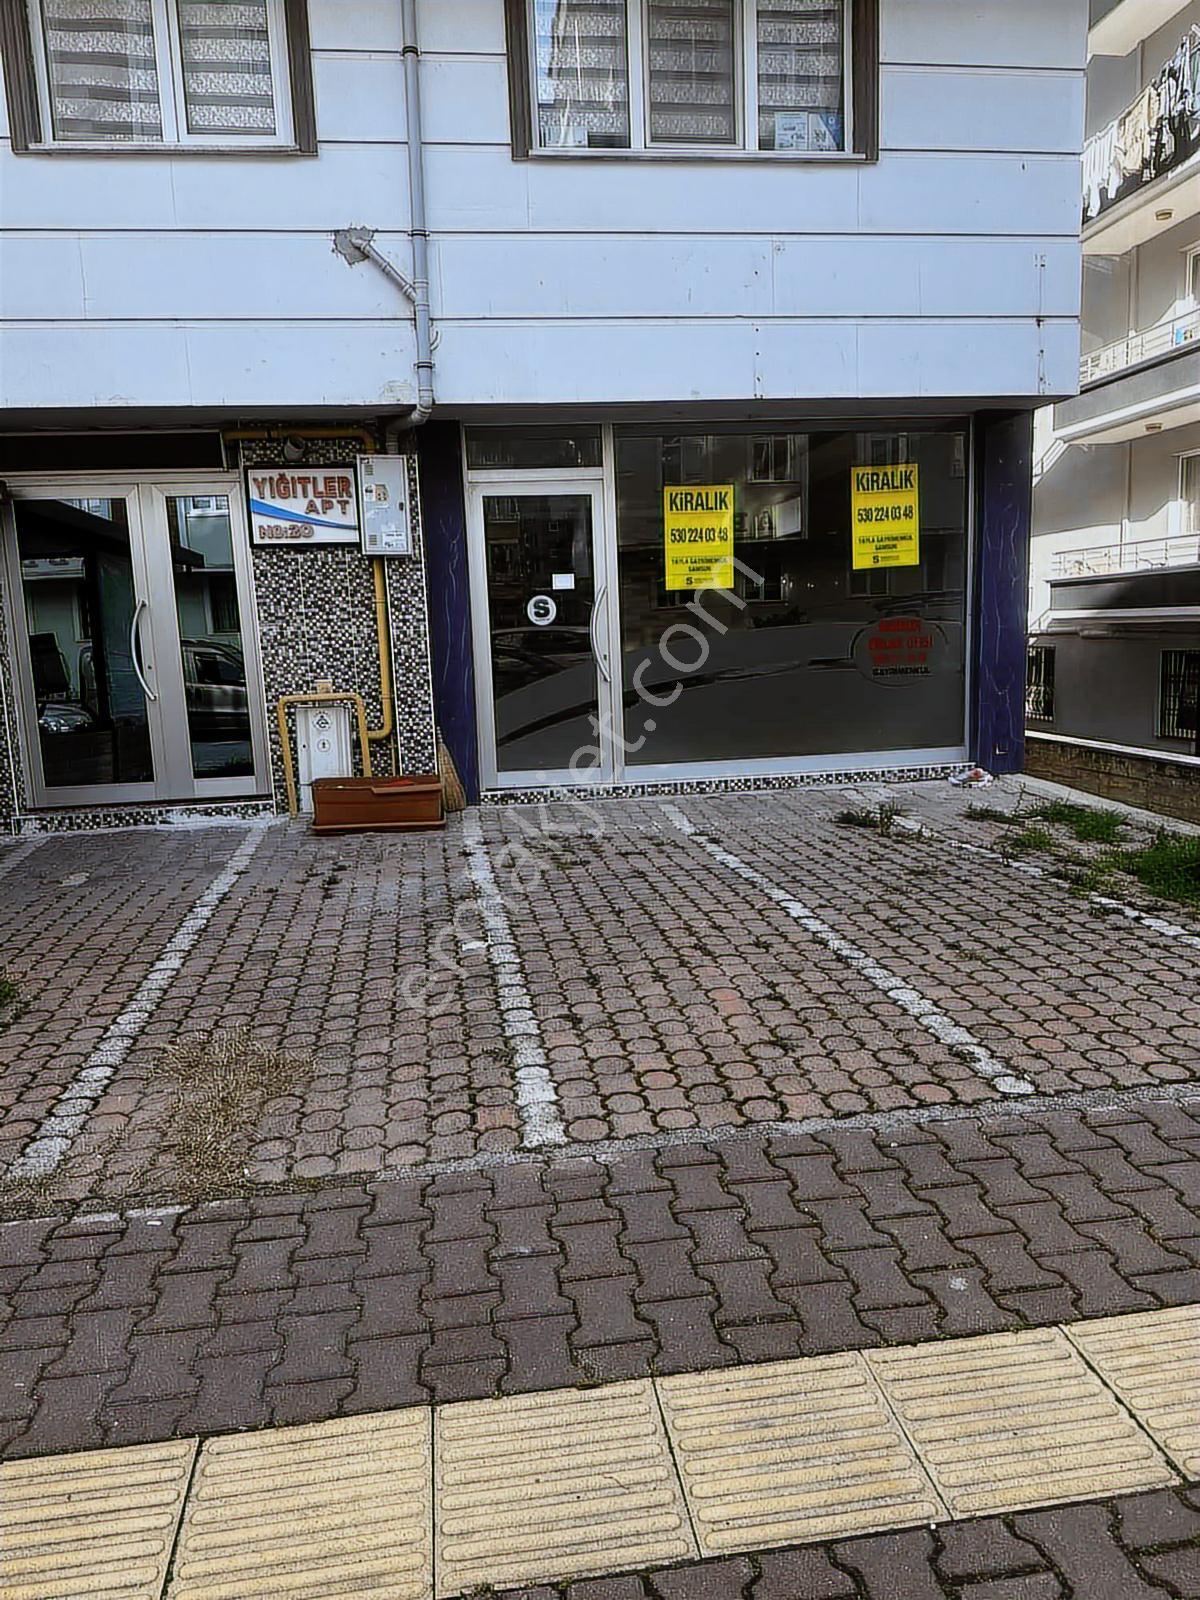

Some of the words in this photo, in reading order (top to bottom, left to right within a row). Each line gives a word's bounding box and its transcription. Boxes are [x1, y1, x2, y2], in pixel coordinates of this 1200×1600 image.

[305, 499, 350, 515] APT
[857, 507, 873, 523] 530
[874, 506, 889, 522] 224
[891, 505, 901, 521] 03
[903, 505, 914, 520] 48
[670, 528, 687, 543] 530
[687, 528, 704, 543] 224
[705, 527, 716, 542] 03
[533, 598, 551, 618] S
